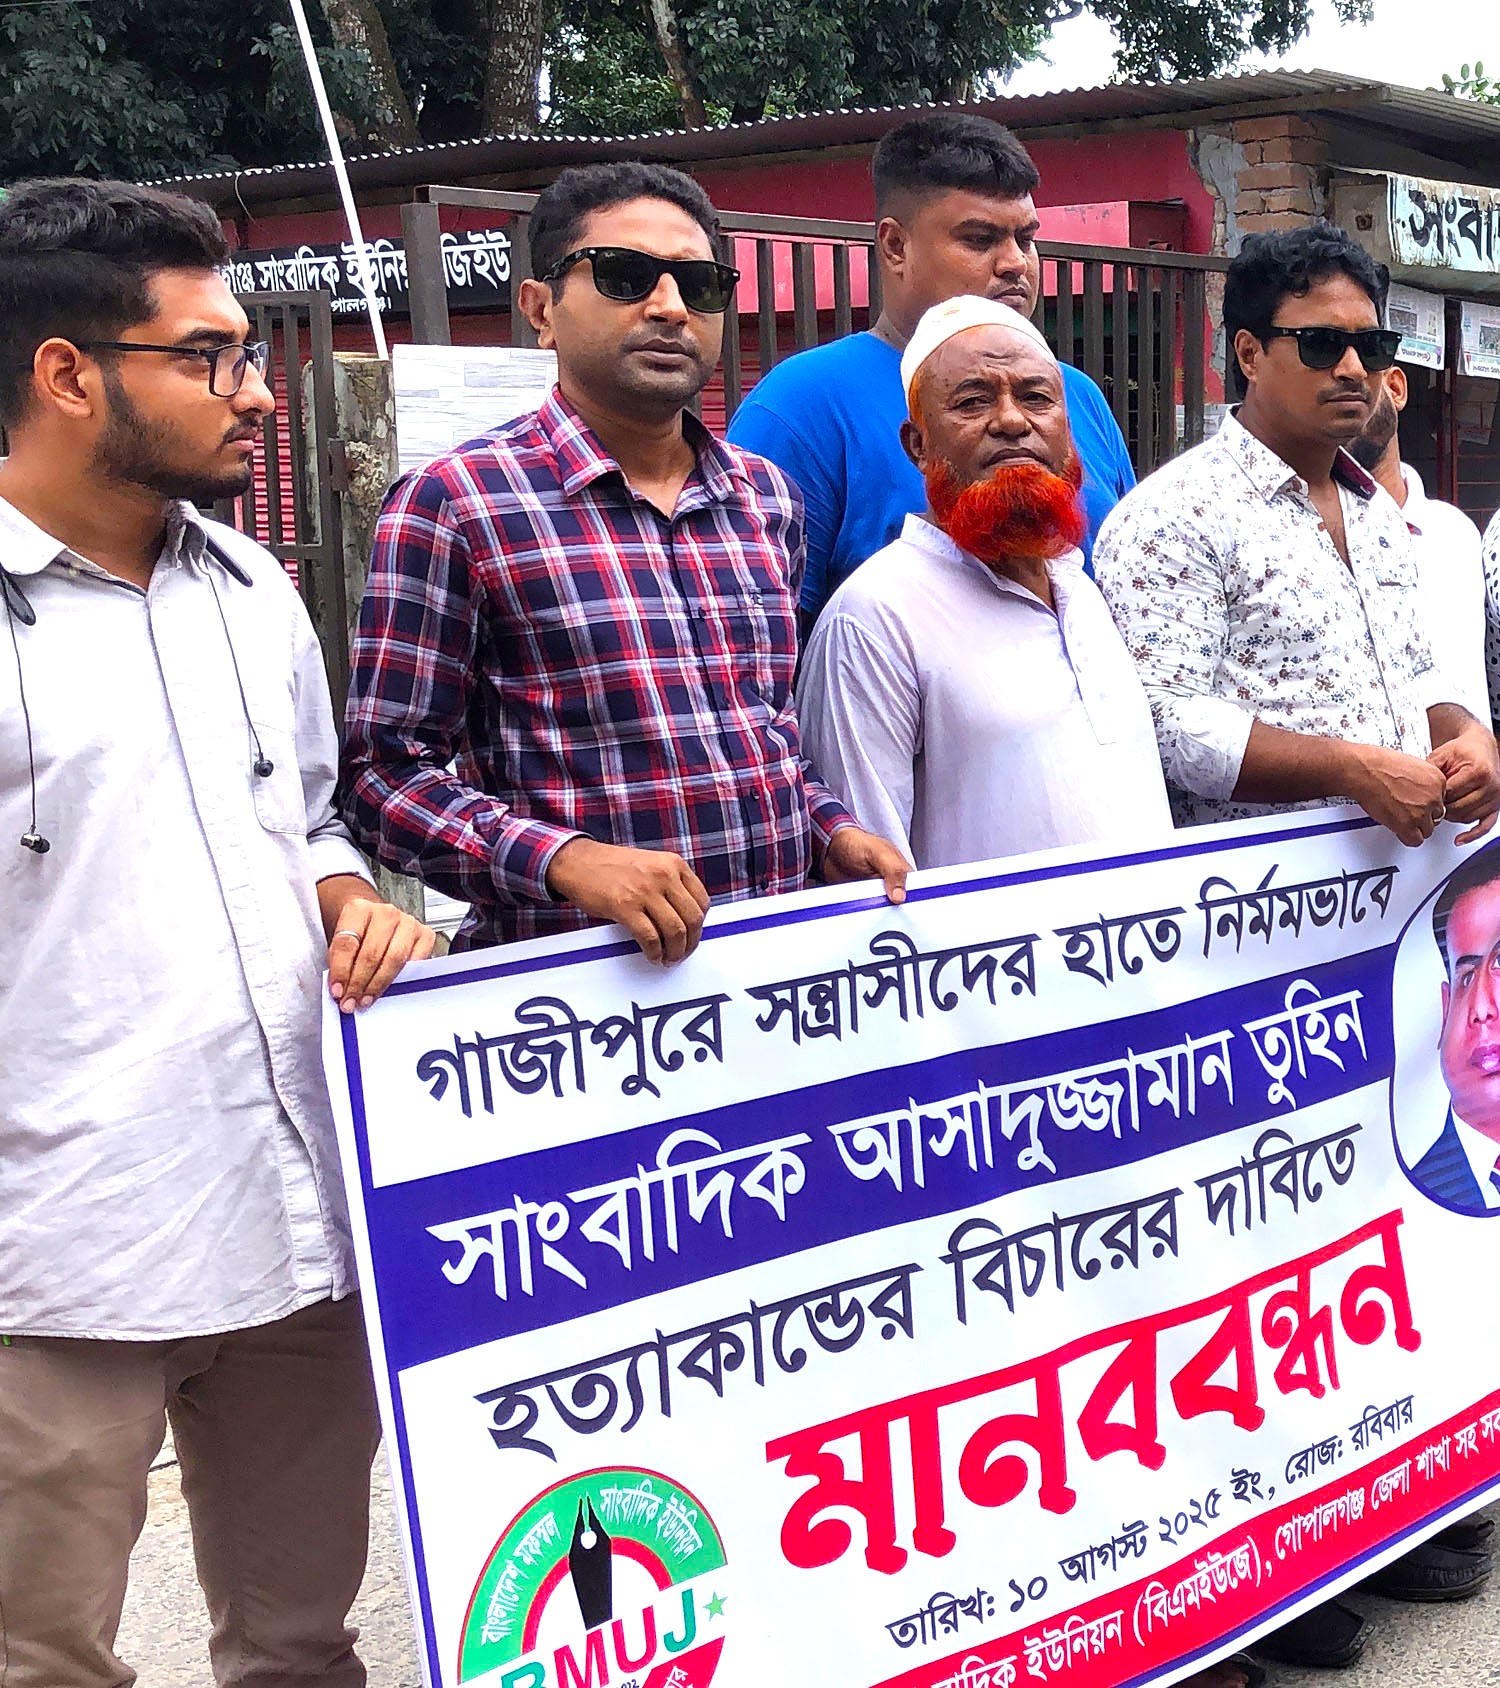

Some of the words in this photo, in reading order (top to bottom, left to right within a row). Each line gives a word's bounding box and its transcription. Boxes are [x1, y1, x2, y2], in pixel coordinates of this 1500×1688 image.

[255, 245, 340, 296] সাংবাদিক
[415, 996, 733, 1119] গাজীপুরে
[745, 930, 1039, 1046] সন্ত্রাসীদের
[1053, 905, 1186, 990] হাতে
[1197, 864, 1400, 959] নির্মমভাবে
[426, 1127, 813, 1302] সাংবাদিক
[827, 1028, 1235, 1193] আসাদুজ্জামান
[1243, 978, 1368, 1110] তুহিন
[473, 1262, 924, 1464] হত্যাকান্ডের
[939, 1187, 1185, 1327] বিচারের
[1194, 1122, 1363, 1237] দাবিতে
[765, 1207, 1421, 1576] মানববন্ধন
[480, 1559, 529, 1646] বাংলাদেশ
[599, 1478, 664, 1529] সাংবাদিক
[655, 1491, 704, 1565] ইউনিয়ন
[1009, 1574, 1049, 1614] ১০
[1057, 1519, 1149, 1585] আগস্ট
[1158, 1488, 1221, 1546] ২০২৫
[1350, 1394, 1415, 1453] রবিবার
[1023, 1610, 1124, 1682] ইউনিয়ন
[1275, 1485, 1365, 1560] গোপালগঞ্জ
[1371, 1459, 1411, 1511] জেলা
[1415, 1434, 1450, 1481] শাখা
[1455, 1421, 1479, 1460] সহ
